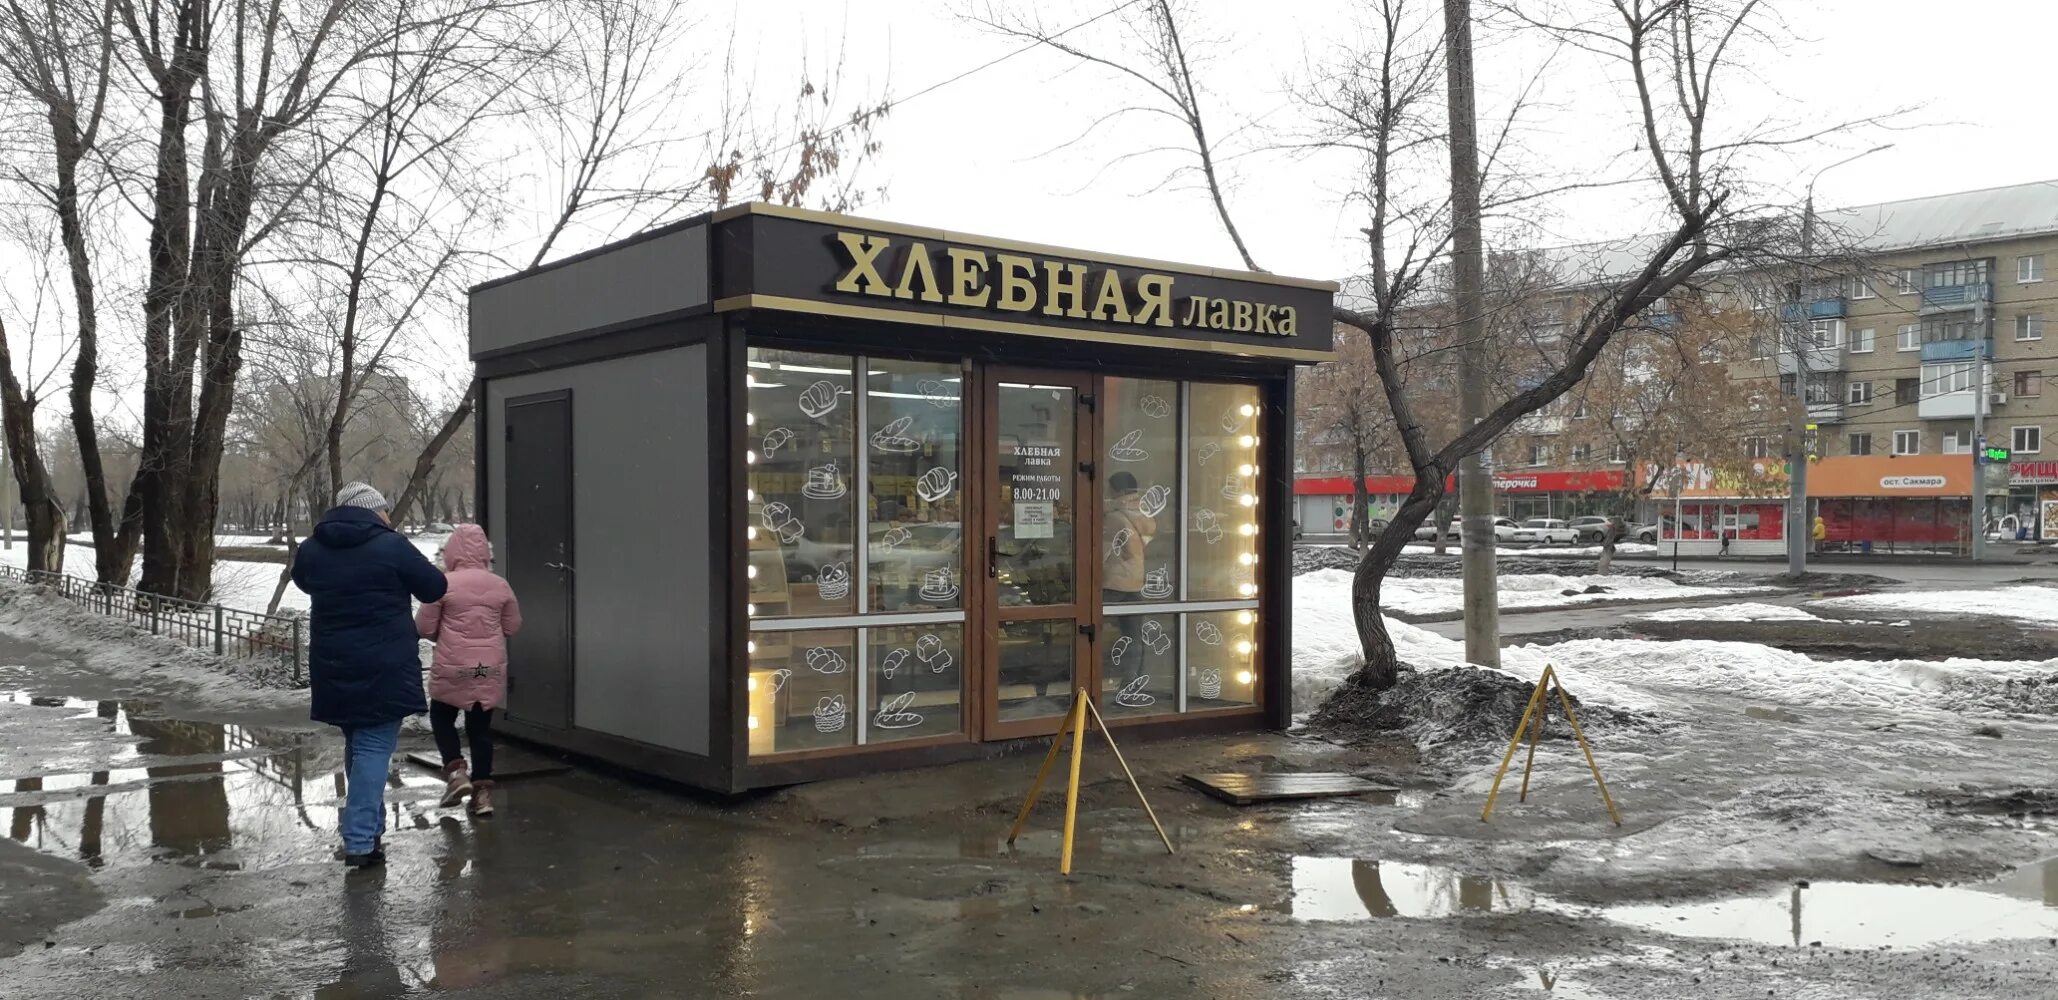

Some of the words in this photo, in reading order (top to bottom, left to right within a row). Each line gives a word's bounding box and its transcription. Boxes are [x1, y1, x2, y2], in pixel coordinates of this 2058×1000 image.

[836, 231, 1174, 327] ХЛЕБНАЯ
[1183, 294, 1298, 337] лавка
[1014, 447, 1060, 456] ХЛЕБНАЯ
[1903, 477, 1942, 486] Сакмара
[1014, 488, 1060, 500] 8.00-21.00
